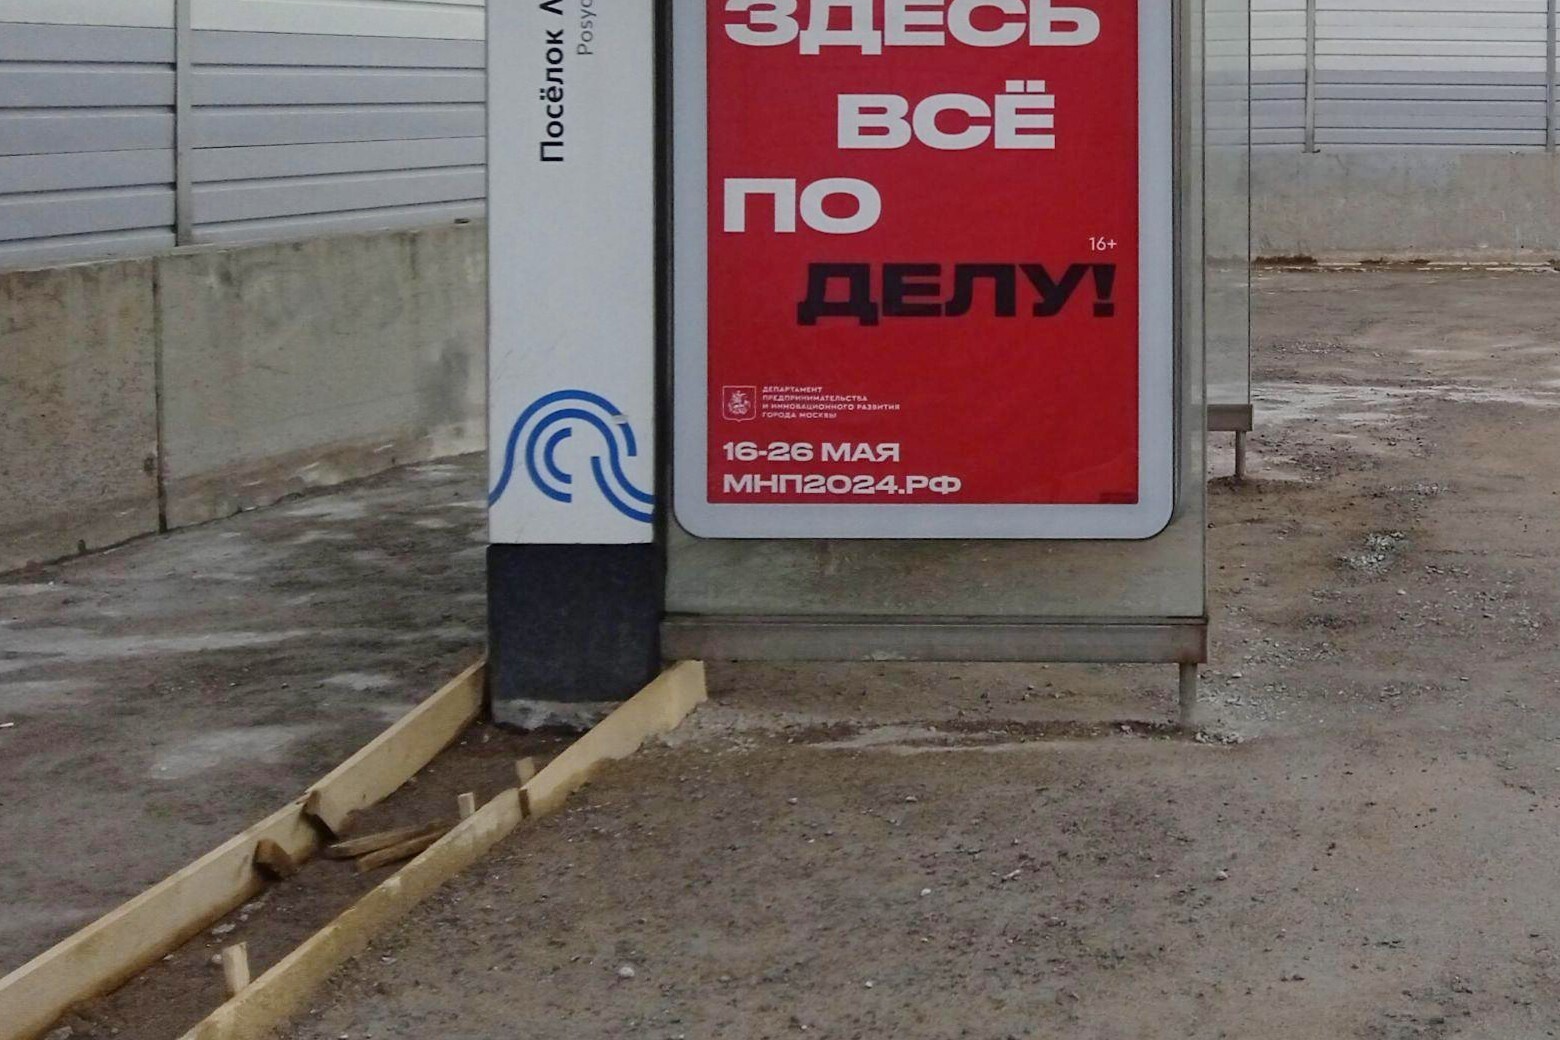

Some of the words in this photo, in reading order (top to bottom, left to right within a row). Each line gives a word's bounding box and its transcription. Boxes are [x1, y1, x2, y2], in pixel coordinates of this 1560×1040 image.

[539, 28, 565, 162] Посёлок
[837, 80, 1056, 150] ВСЁ
[723, 177, 882, 234] ПО
[1088, 236, 1118, 252] 16+
[797, 263, 1117, 326] ДЕЛУ!
[762, 386, 823, 394] ДЕПАРТАМЕНТ
[723, 441, 814, 462] 16-26
[821, 442, 900, 462] МАЯ
[723, 473, 962, 495] МНП2024.РФ
